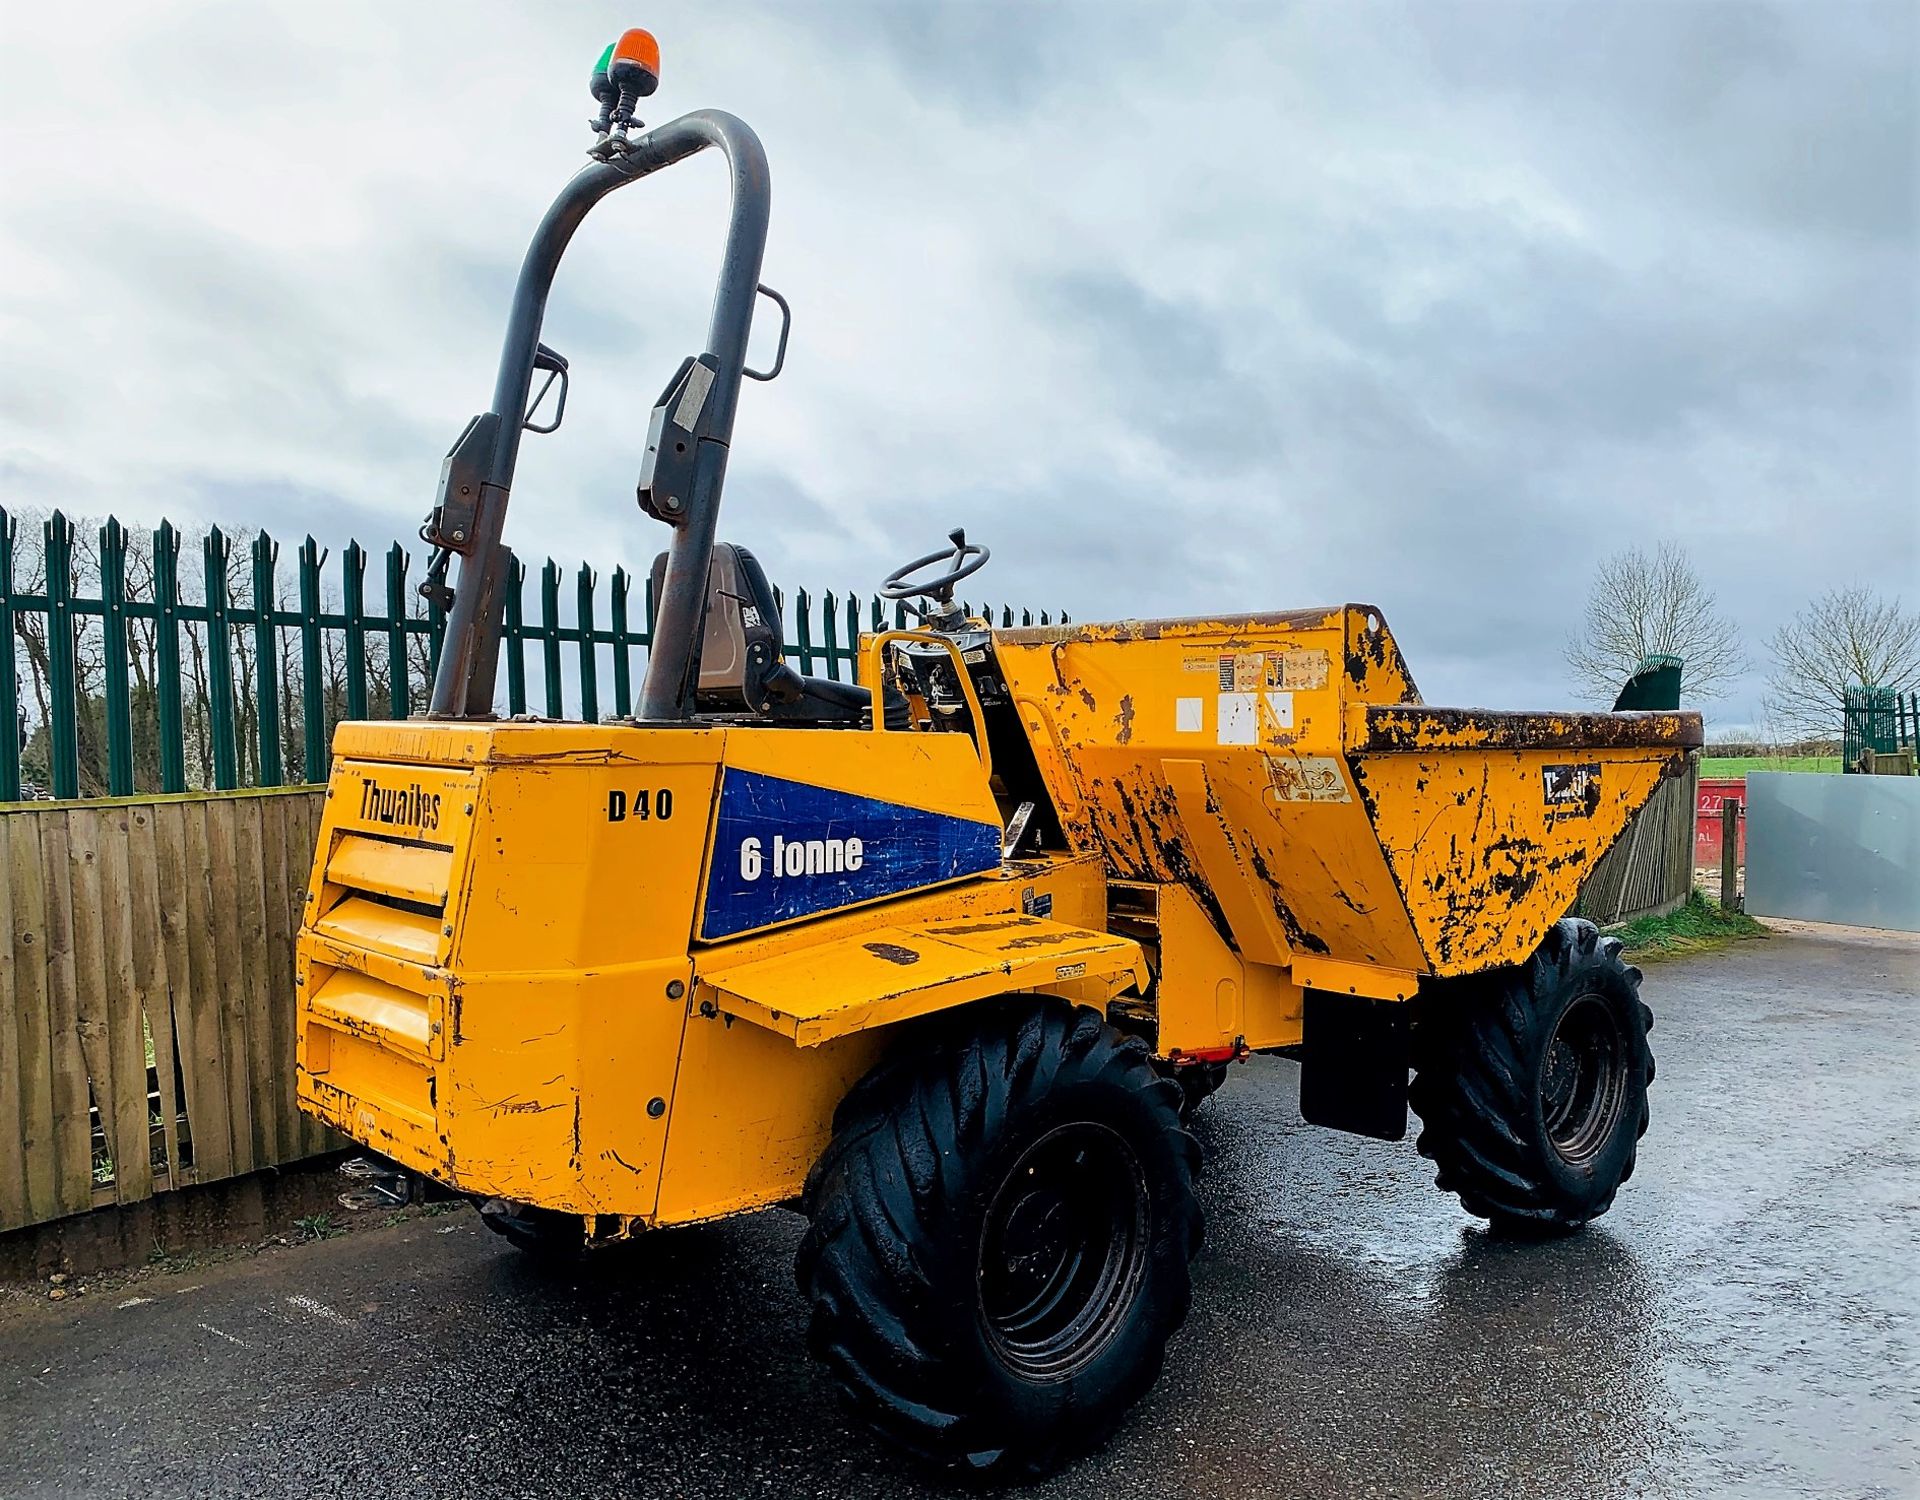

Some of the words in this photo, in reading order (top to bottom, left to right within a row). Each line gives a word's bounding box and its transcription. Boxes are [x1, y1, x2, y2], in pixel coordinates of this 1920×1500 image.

[360, 778, 441, 831] Thwaites
[740, 836, 762, 881] 6
[773, 834, 864, 878] tonne
